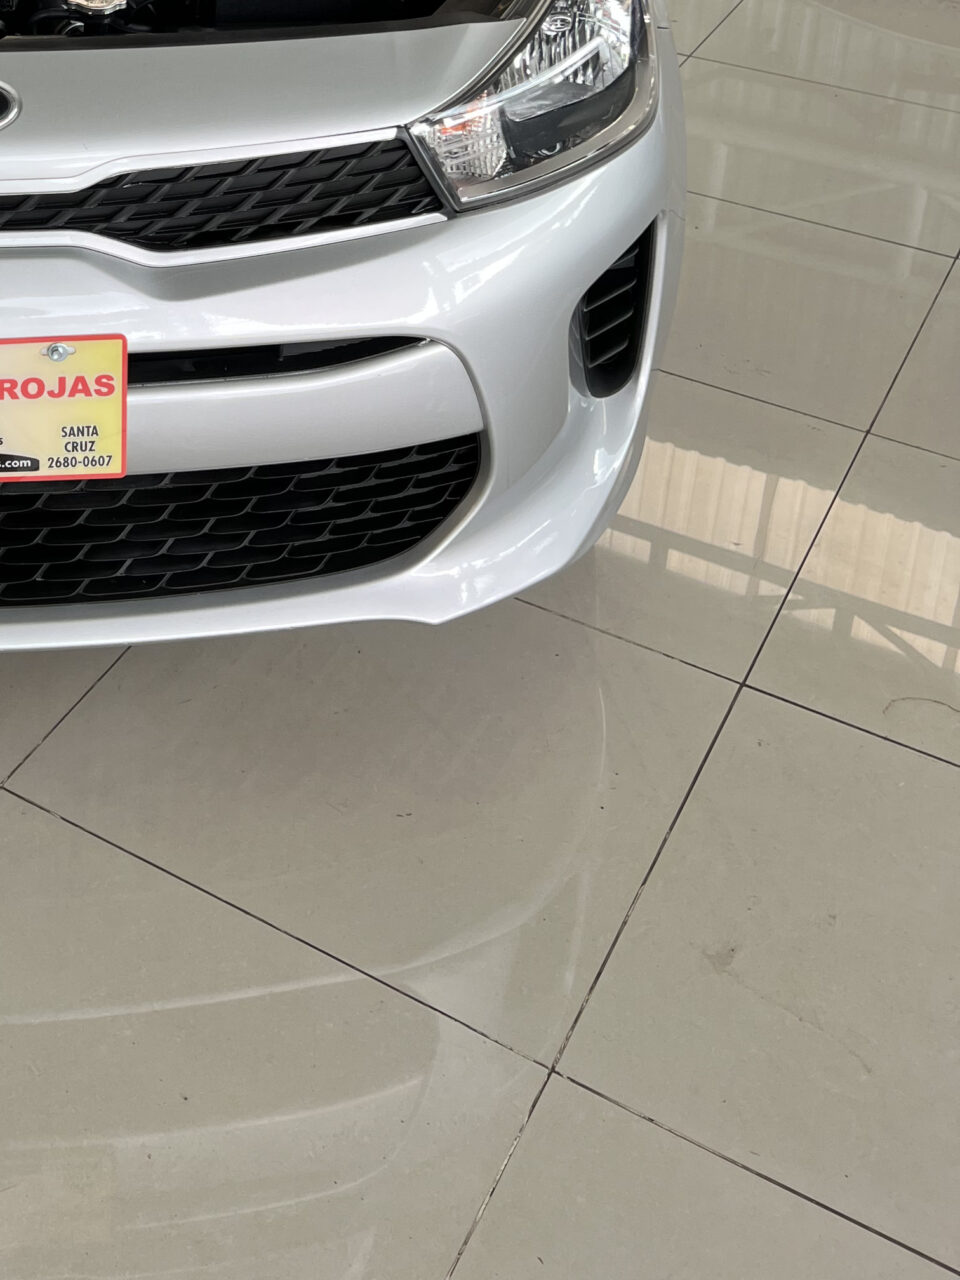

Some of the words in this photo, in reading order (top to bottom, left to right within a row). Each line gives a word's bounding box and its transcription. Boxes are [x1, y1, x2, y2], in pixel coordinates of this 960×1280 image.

[61, 425, 99, 438] SANTA
[64, 440, 96, 453] CRUZ
[47, 455, 113, 469] 2680-0607
